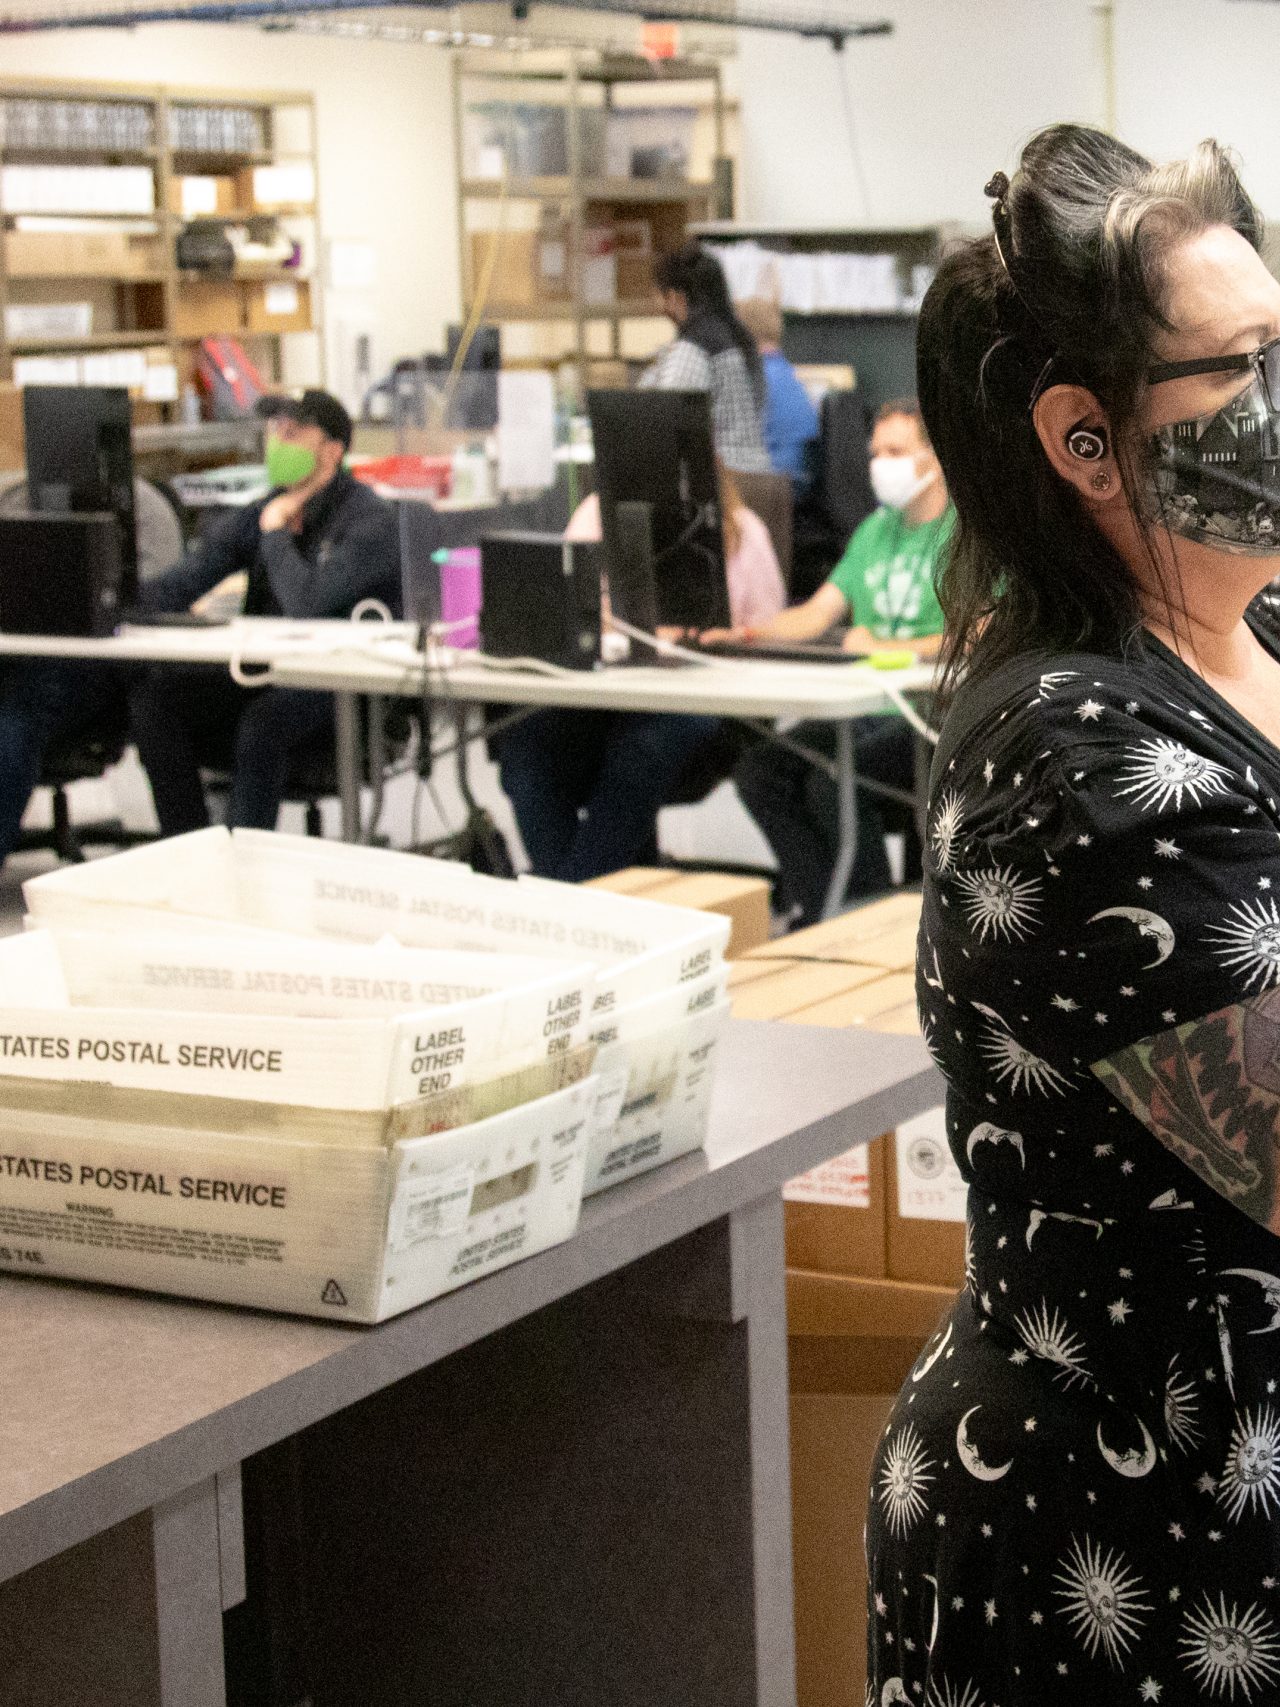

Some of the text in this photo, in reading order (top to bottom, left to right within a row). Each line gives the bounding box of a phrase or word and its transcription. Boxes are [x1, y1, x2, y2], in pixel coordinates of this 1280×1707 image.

[547, 990, 582, 1016] LABEL
[415, 1027, 466, 1052] LABEL
[0, 1035, 282, 1072] TATES POSTAL SERVICE
[411, 1048, 465, 1074] OTHER
[419, 1072, 451, 1095] END
[80, 1166, 172, 1196] POSTAL
[180, 1177, 287, 1208] SERVICE
